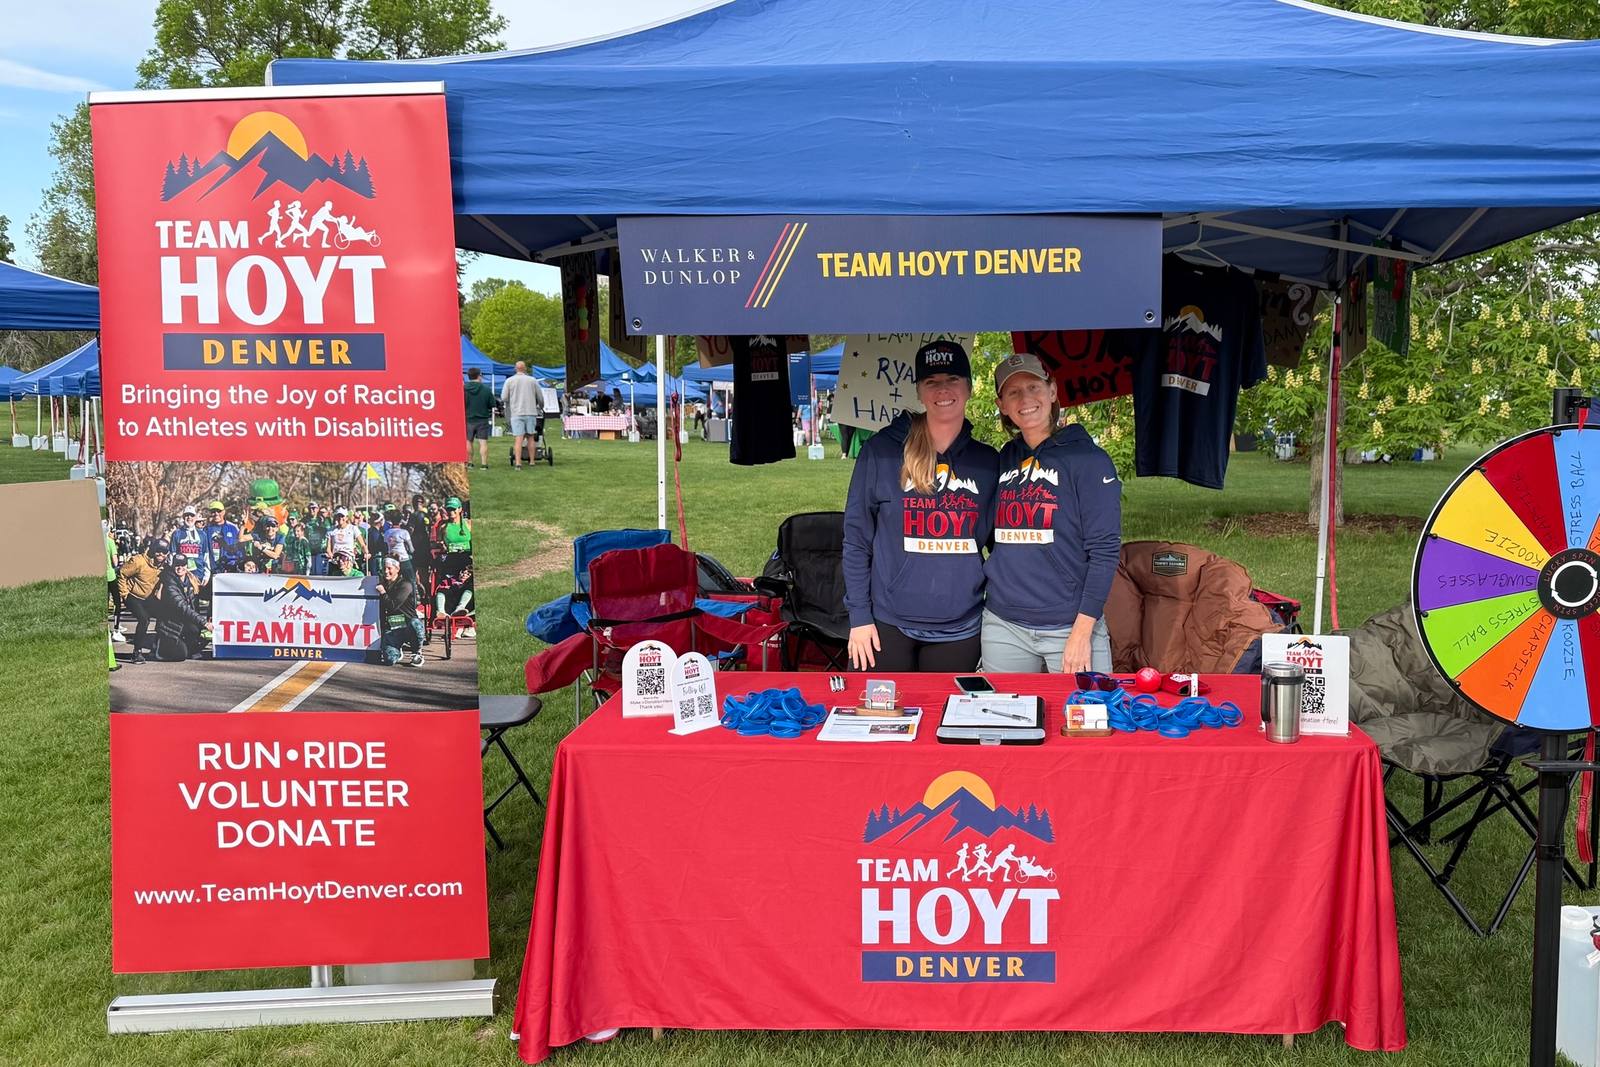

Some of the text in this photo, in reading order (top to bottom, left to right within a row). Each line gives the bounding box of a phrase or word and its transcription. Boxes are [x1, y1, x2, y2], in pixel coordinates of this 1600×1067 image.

[155, 220, 249, 249] TEAM
[641, 248, 756, 264] WALKER &
[817, 247, 1082, 278] TEAM HOYT DENVER
[160, 255, 386, 326] HOYT
[644, 269, 741, 286] DUNLOP
[202, 339, 352, 365] DENVER
[925, 352, 954, 364] HOYT
[877, 357, 917, 386] RYA
[121, 384, 436, 410] Bringing the Joy of Racing
[118, 417, 444, 437] to Athletes with Disabilities
[903, 497, 936, 509] TEAM
[1570, 452, 1585, 546] STRESS BALL
[903, 510, 979, 537] HOYT
[995, 501, 1058, 528] HOYT
[918, 541, 970, 552] DENVER
[1000, 531, 1043, 542] DENVER
[1485, 528, 1544, 567] KOOZIE
[1544, 552, 1597, 582] LUCKY SPIN
[1438, 573, 1536, 589] SUNGLASSES
[219, 620, 376, 648] TEAM HOYT
[1452, 597, 1540, 650] STRESS BALL
[274, 648, 323, 658] DENVER
[639, 655, 662, 663] HOYT
[1500, 614, 1553, 690] CHAPSTICK
[1562, 623, 1576, 681] KOOZIE
[684, 667, 700, 676] HOYT
[178, 779, 410, 810] VOLUNTEER
[216, 819, 376, 848] DONATE
[856, 858, 939, 882] TEAM
[134, 880, 463, 905] www.TeamHoytDenver.com
[861, 887, 1061, 945] HOYT
[895, 956, 1025, 978] DENVER
